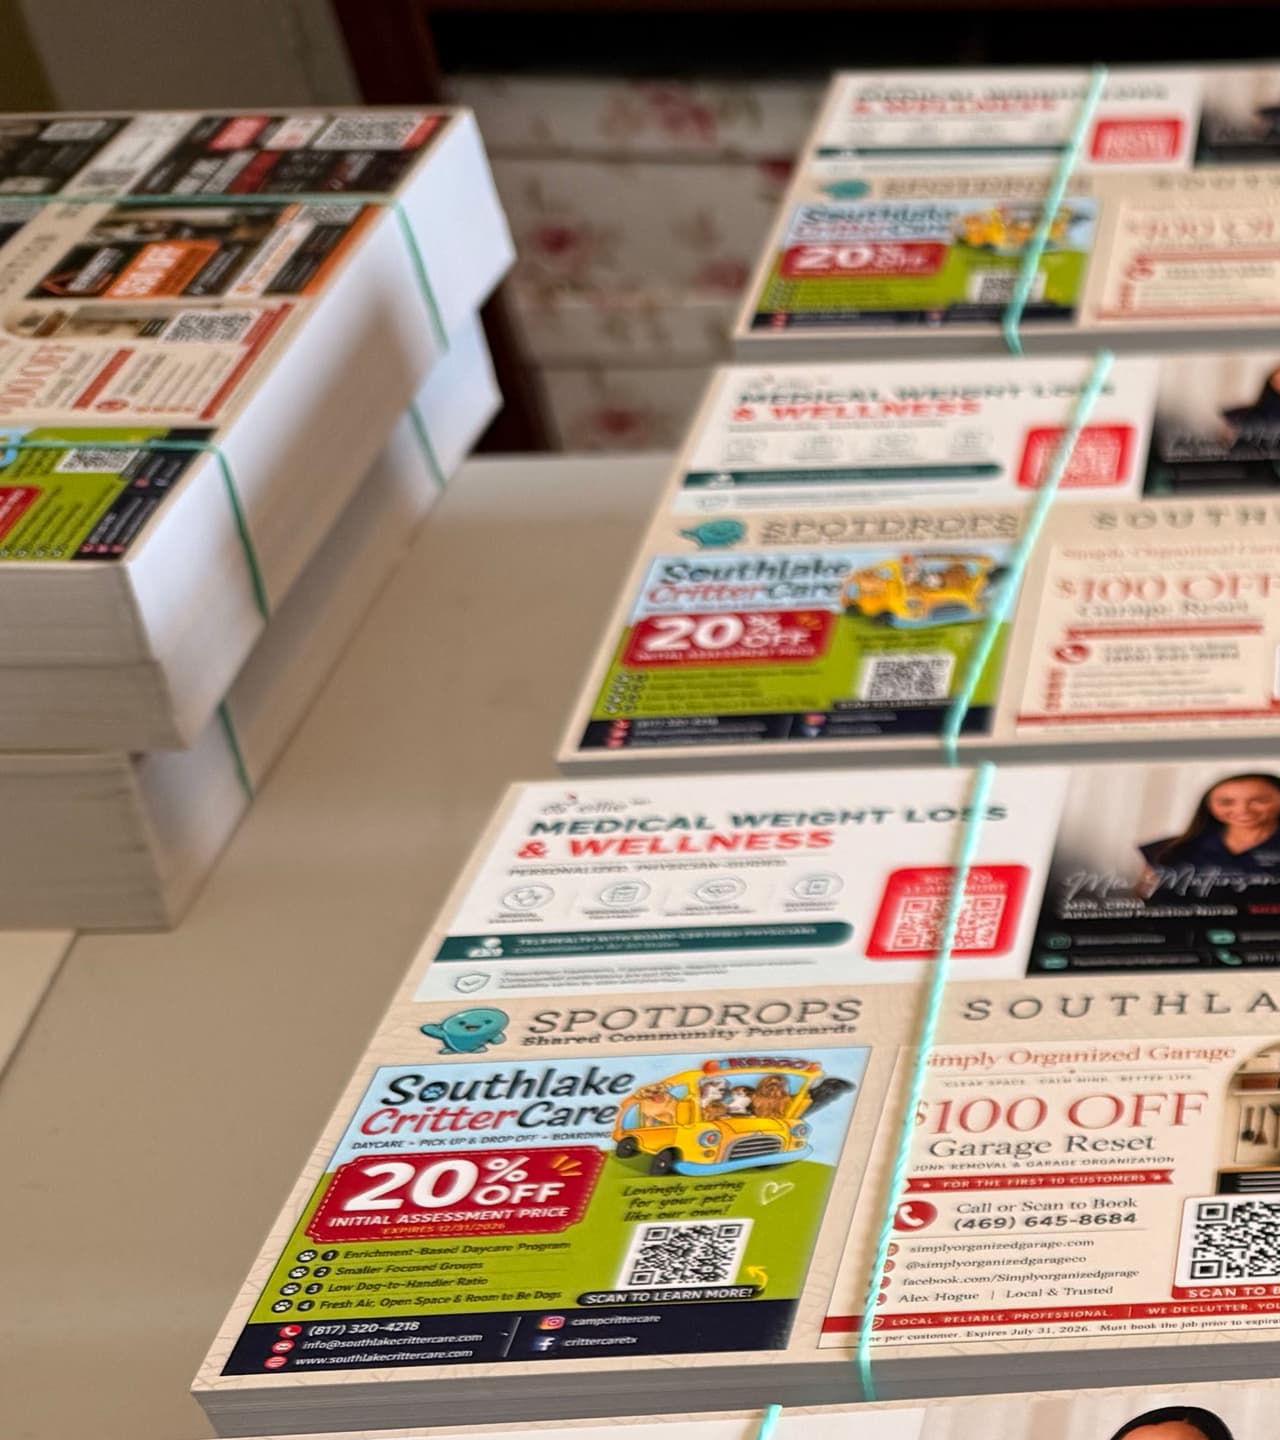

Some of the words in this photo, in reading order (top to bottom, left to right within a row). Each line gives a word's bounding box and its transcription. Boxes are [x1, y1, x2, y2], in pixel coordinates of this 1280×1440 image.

[527, 999, 864, 1035] SPOTDROPS
[379, 1067, 636, 1109] Southlake
[360, 1102, 620, 1137] CritterCare
[341, 1153, 530, 1215] 20%
[478, 1179, 566, 1205] OFF
[952, 1214, 1018, 1232] (469)
[1021, 1210, 1138, 1230] 645-8684
